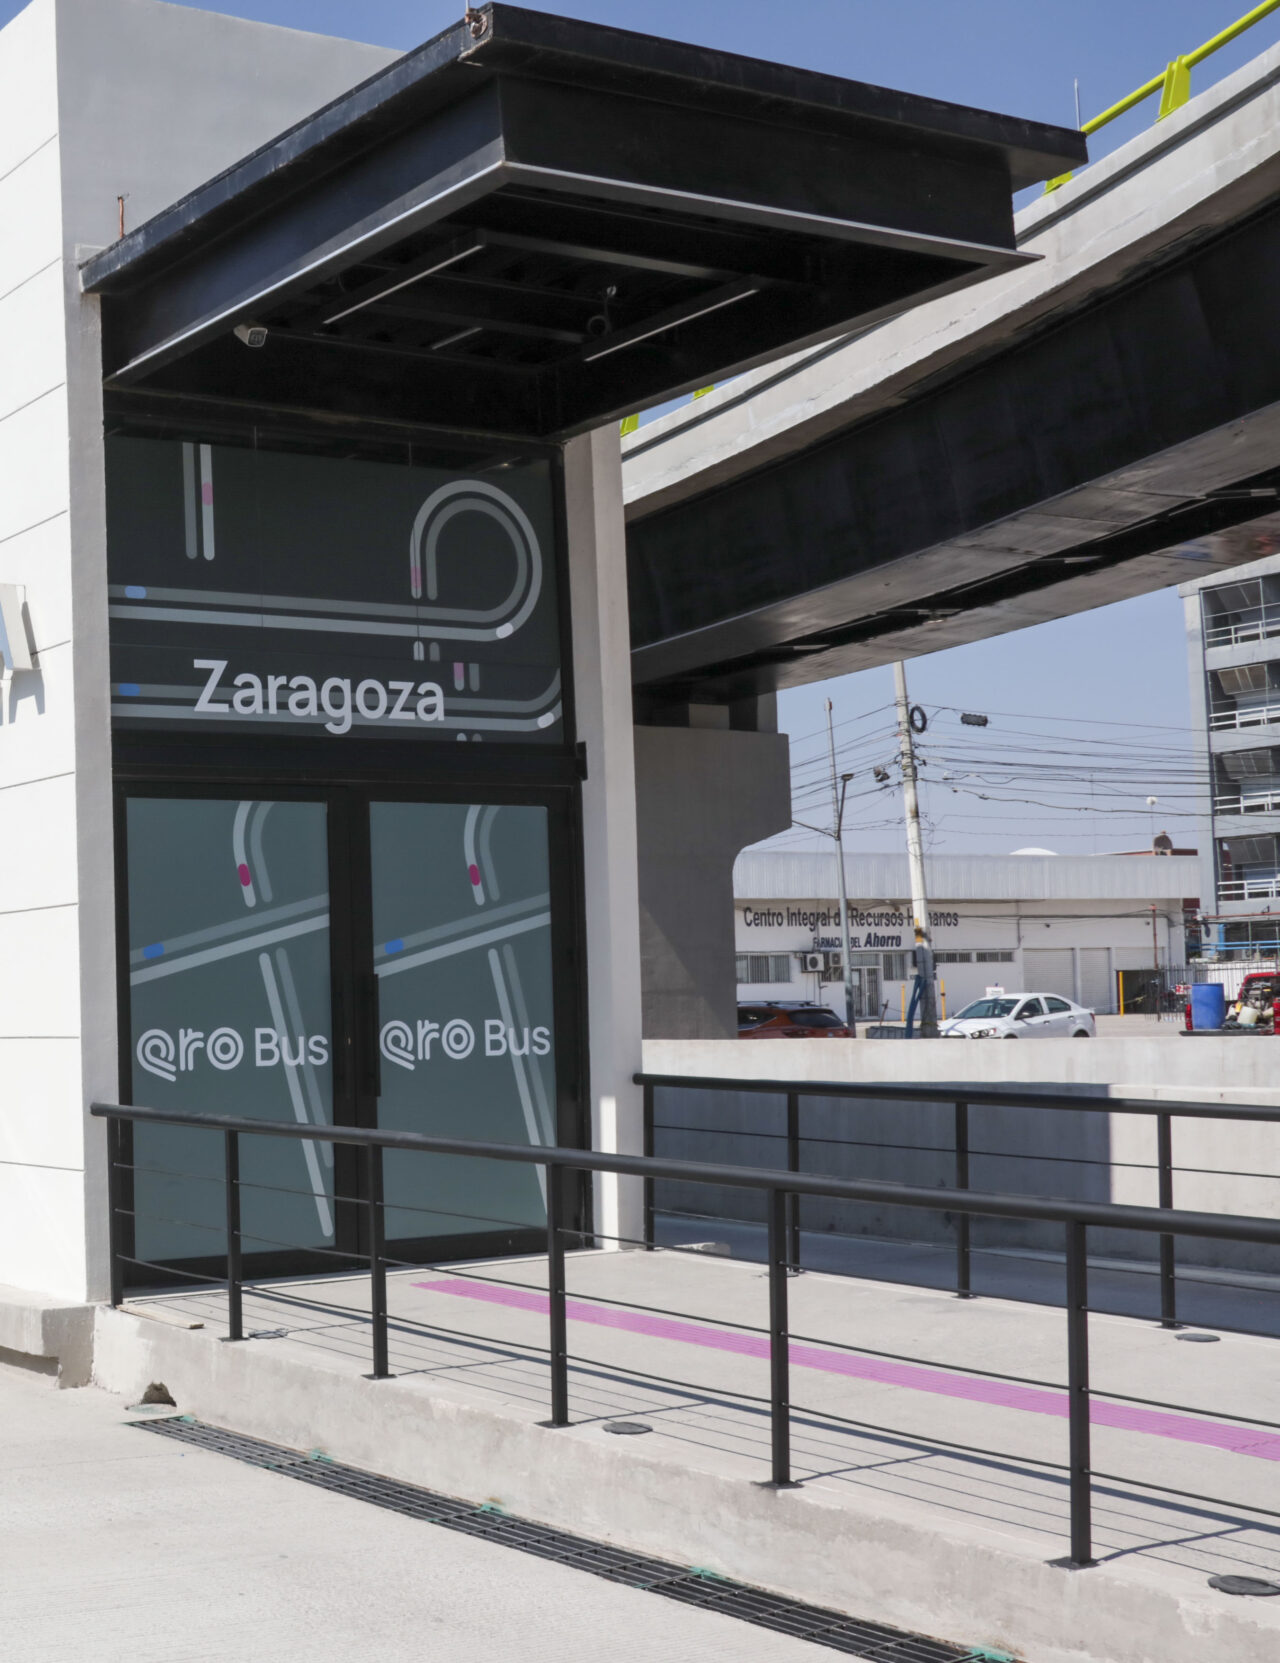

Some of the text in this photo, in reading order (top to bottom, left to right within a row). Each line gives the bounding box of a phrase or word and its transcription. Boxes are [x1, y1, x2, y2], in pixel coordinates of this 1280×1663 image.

[192, 658, 445, 735] Zaragoza
[743, 906, 784, 928] Centro
[786, 906, 831, 932] Integral
[851, 906, 904, 928] Recursos
[907, 907, 959, 928] Hanos
[850, 936, 862, 948] DEL
[864, 932, 902, 948] Ahorro
[254, 1027, 329, 1068] Bus
[484, 1018, 551, 1058] Bus
